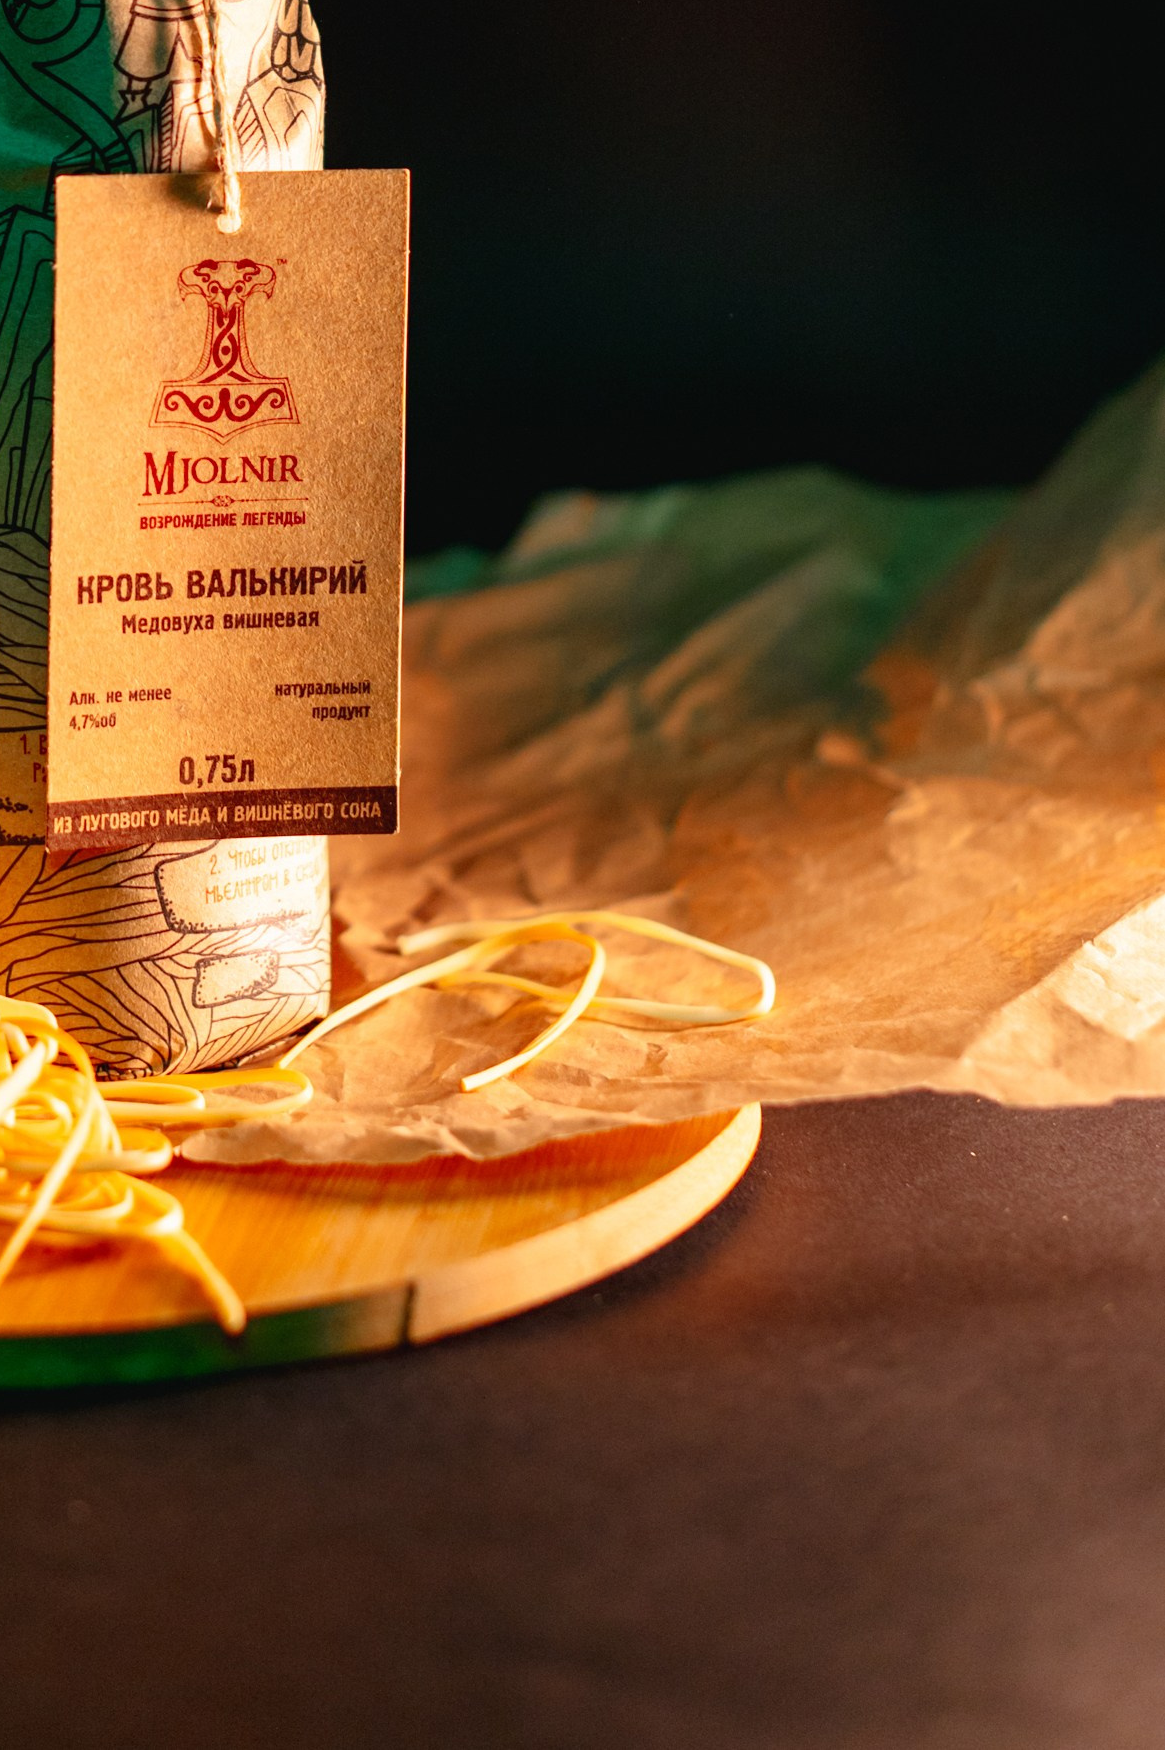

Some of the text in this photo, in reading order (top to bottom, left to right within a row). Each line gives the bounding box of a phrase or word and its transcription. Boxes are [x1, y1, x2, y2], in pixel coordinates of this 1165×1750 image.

[139, 510, 306, 530] ВОЗРОЖДЕНИЕ ЛЕГЕНДЫ
[77, 559, 368, 605] КРОВЬ ВАЛЬКИРИЙ
[122, 610, 320, 636] Медовуха вишневая
[69, 687, 172, 706] Алк. не менее
[274, 679, 371, 699] натуральный
[311, 705, 371, 722] продукт
[178, 754, 255, 787] 0,75л
[53, 800, 381, 835] ИЗ ЛУГОВОГО МЁДА И ВИШНЁВОГО СОКА
